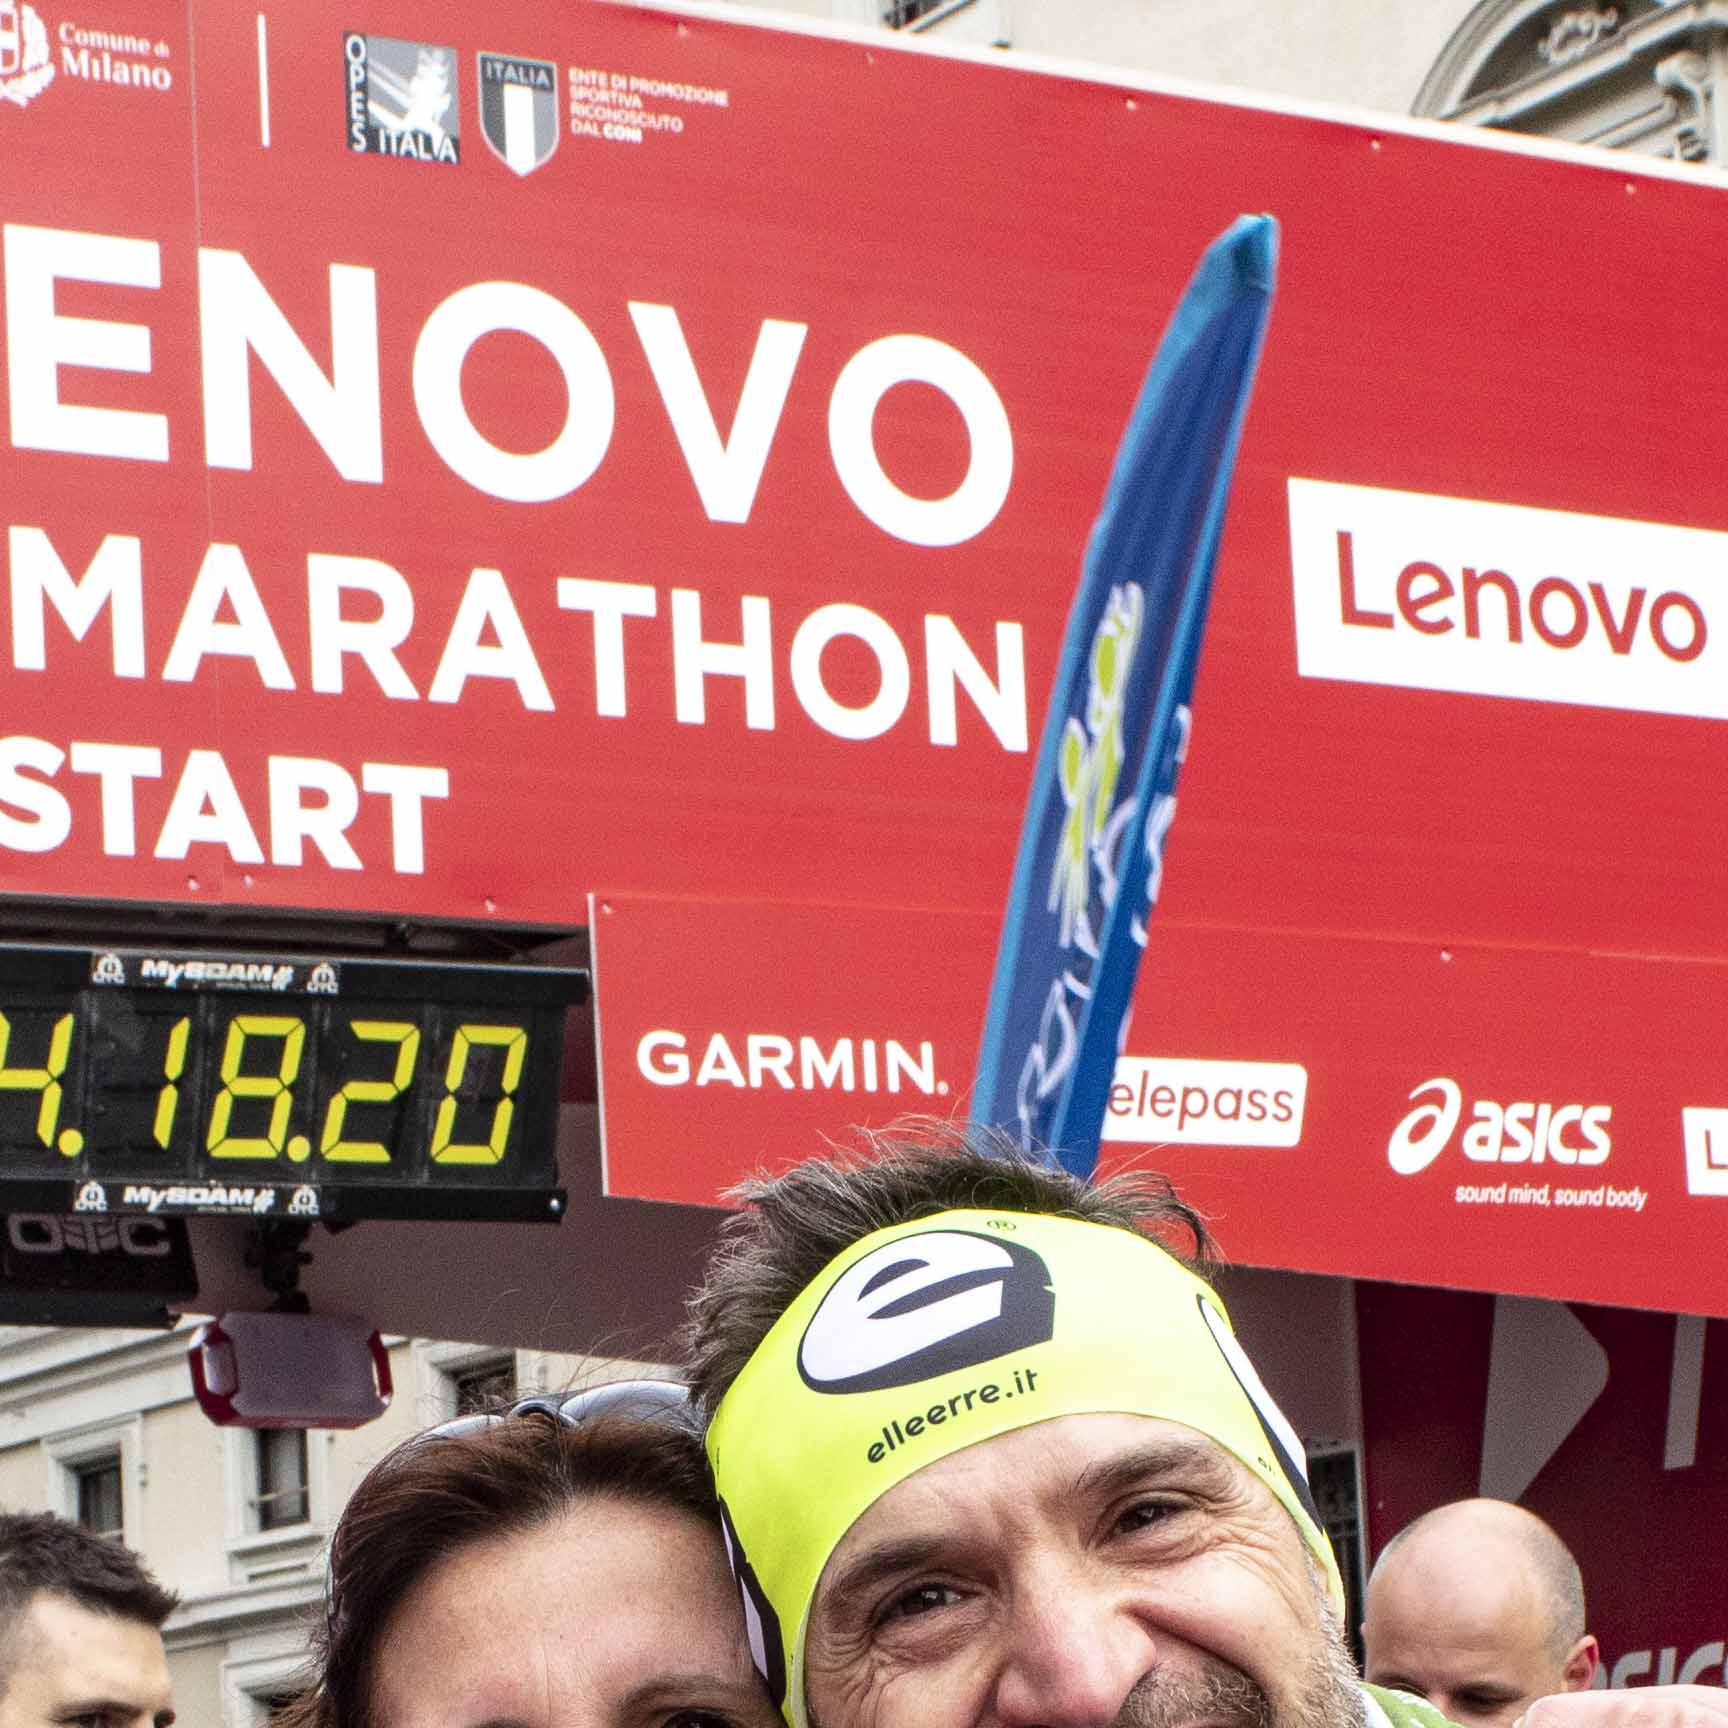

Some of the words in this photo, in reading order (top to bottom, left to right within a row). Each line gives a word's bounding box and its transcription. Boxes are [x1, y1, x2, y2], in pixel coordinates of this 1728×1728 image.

[60, 22, 149, 57] Comune
[62, 53, 172, 92] Milano
[345, 34, 368, 153] OPES
[484, 60, 552, 88] ITALIA
[570, 67, 608, 87] ENTE
[629, 76, 730, 108] PROMOZIONE
[1335, 529, 1709, 664] Lenovo
[8, 524, 1030, 754] MARATHON
[1106, 1066, 1295, 1134] elepass
[1455, 1183, 1508, 1205] sound
[1554, 1186, 1605, 1207] sound
[1606, 1185, 1648, 1213] body
[865, 1367, 1040, 1467] elleerre.it
